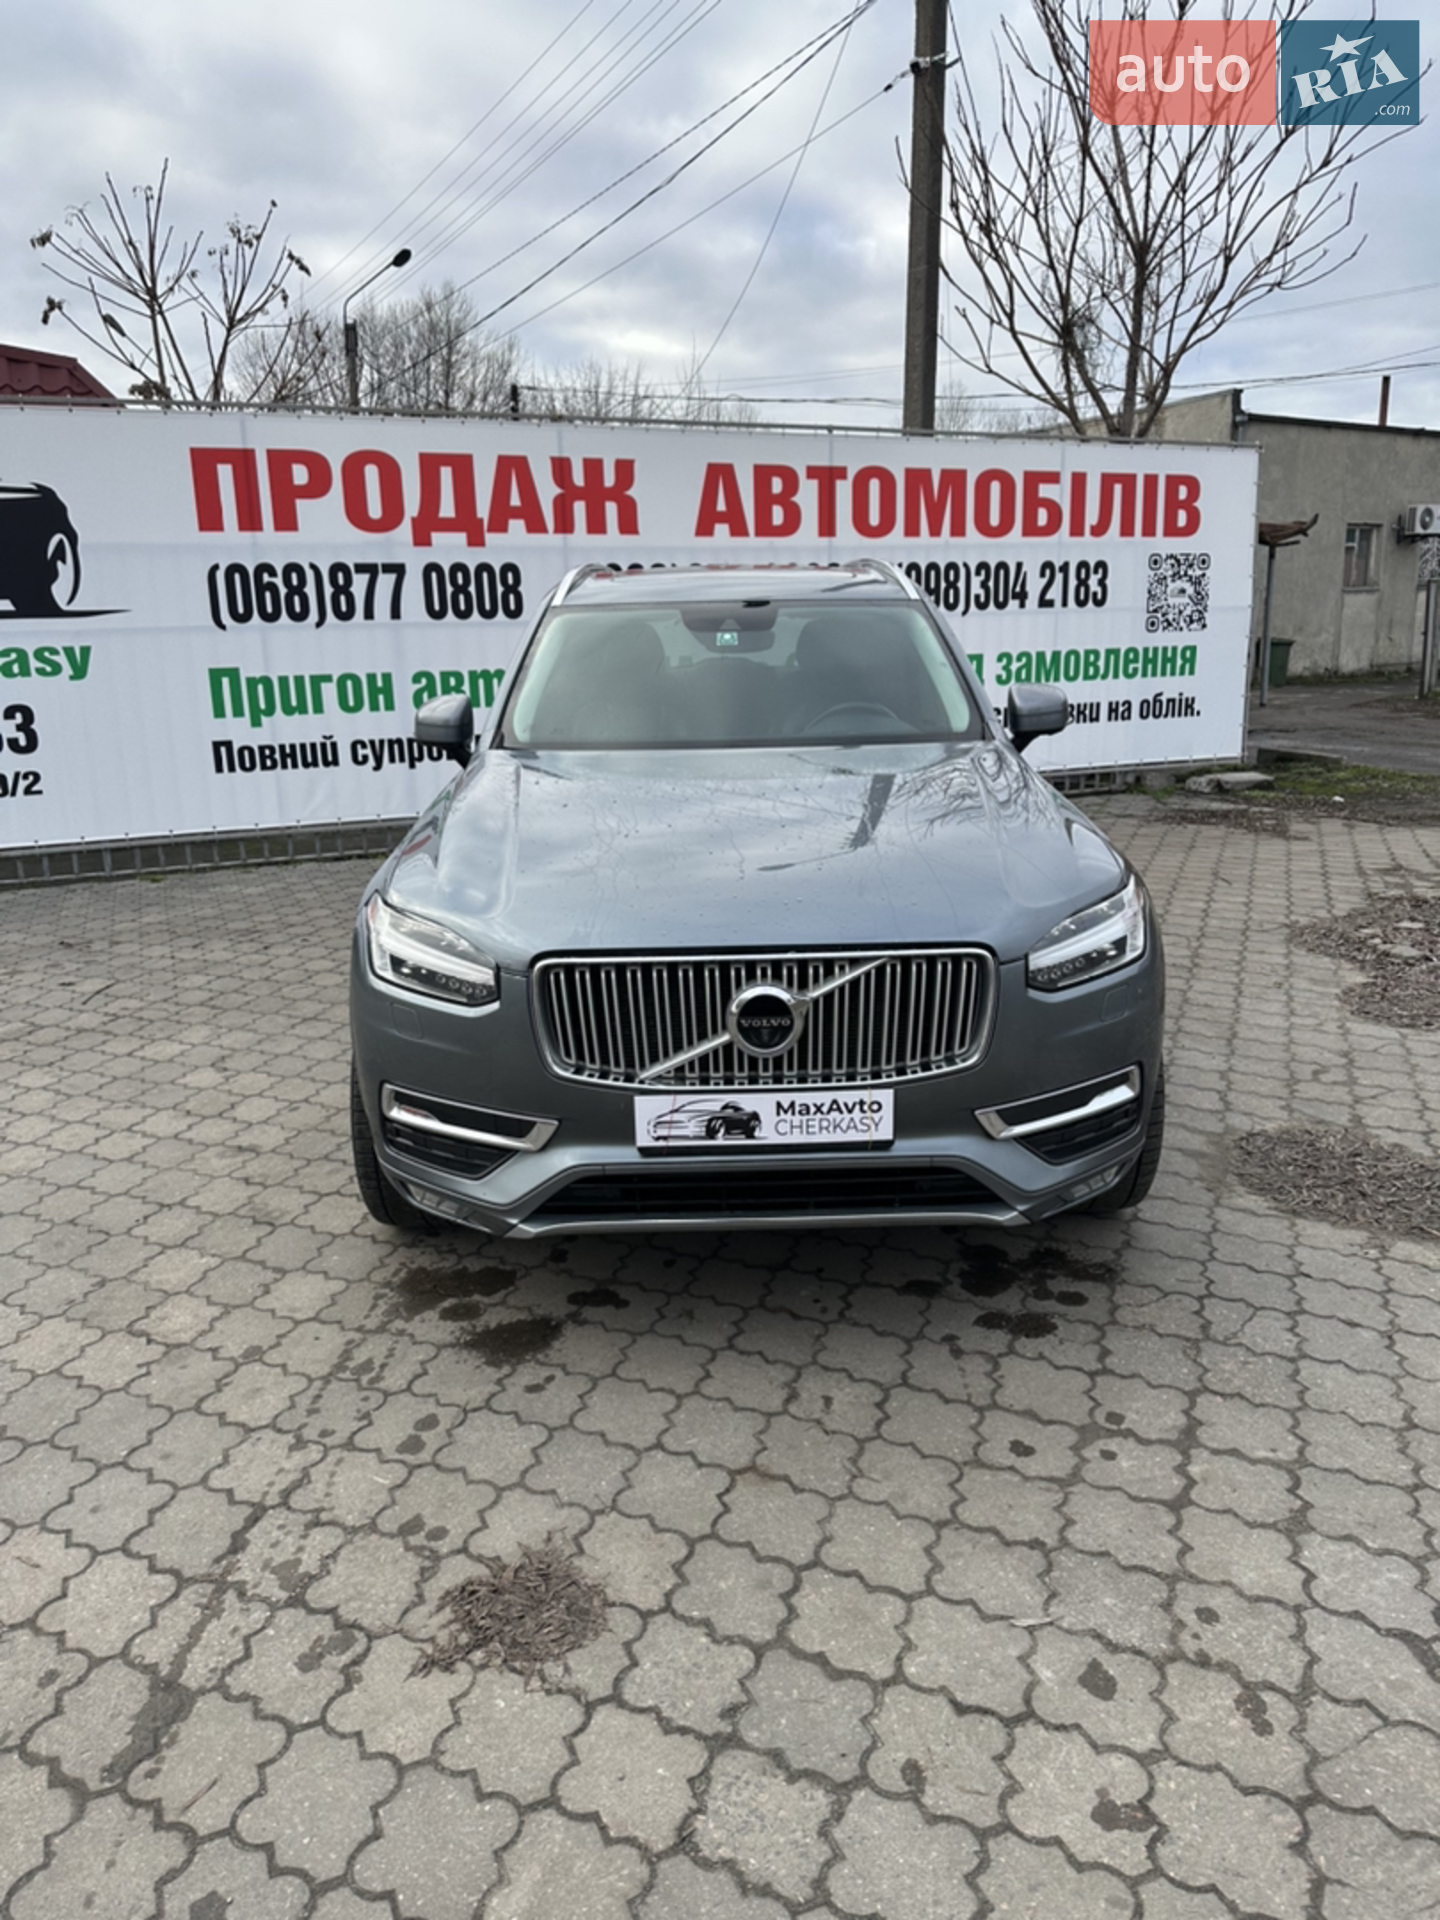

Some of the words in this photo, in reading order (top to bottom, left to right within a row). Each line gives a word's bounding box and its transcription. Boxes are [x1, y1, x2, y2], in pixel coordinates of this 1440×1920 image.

[189, 447, 639, 547] ПРОДАЖ
[694, 462, 1201, 539] АВТОМОБІЛІВ
[207, 561, 407, 631] (068)877
[422, 562, 524, 621] 0808
[897, 560, 1029, 617] 98)304
[1037, 560, 1109, 609] 2183
[995, 645, 1198, 687] замовлення
[207, 667, 396, 729] Пригон
[1107, 700, 1132, 722] на
[1139, 691, 1201, 721] облік.
[211, 734, 340, 774] Повний
[740, 1018, 791, 1029] VOLVO
[774, 1116, 884, 1137] CHERKASY
[776, 1098, 883, 1118] MaxAvto
